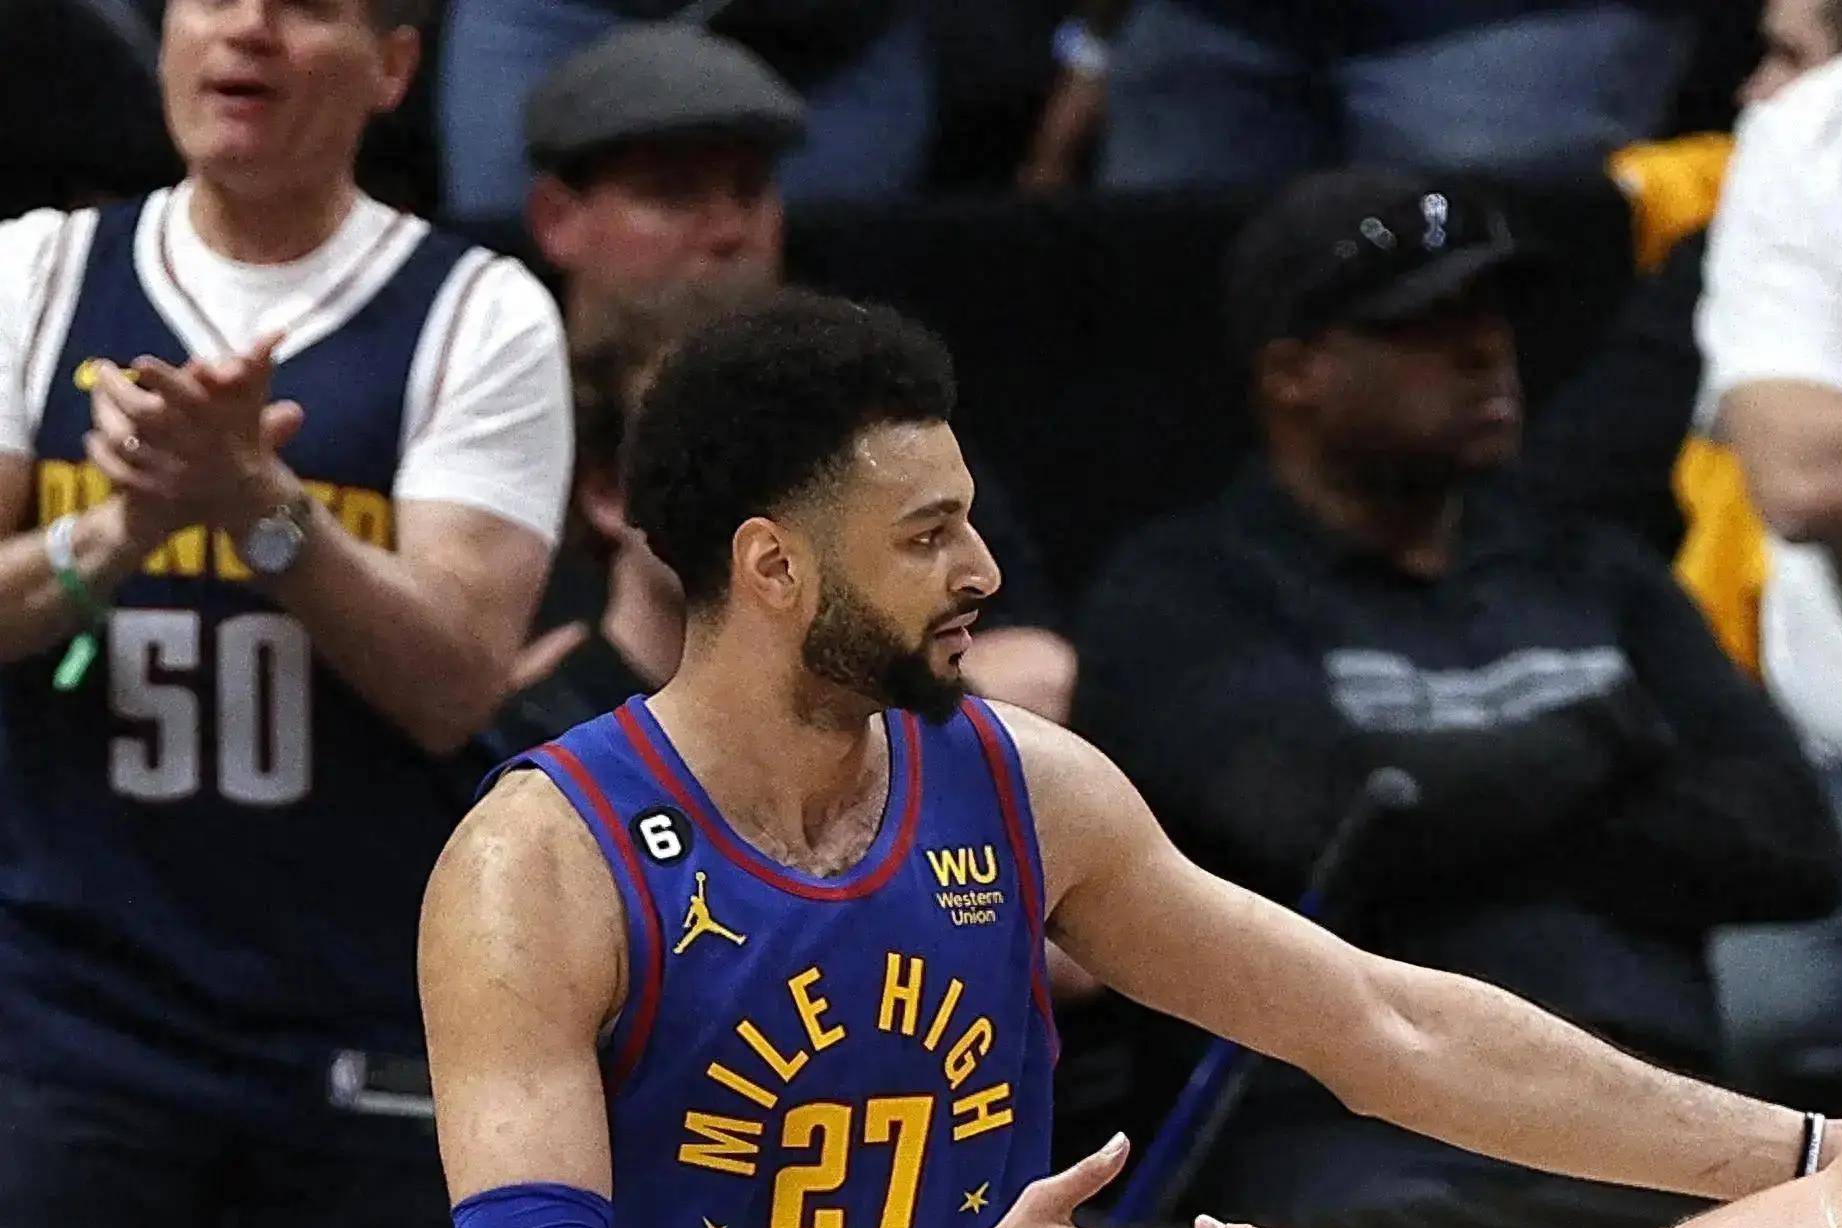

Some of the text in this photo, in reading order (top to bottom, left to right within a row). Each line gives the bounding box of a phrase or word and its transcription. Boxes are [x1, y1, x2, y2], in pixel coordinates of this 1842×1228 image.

[108, 608, 312, 804] 50
[639, 813, 682, 860] 6
[926, 844, 997, 887] WU
[935, 889, 1004, 909] Western
[951, 906, 996, 926] Union
[677, 951, 1015, 1176] MILE HIGH
